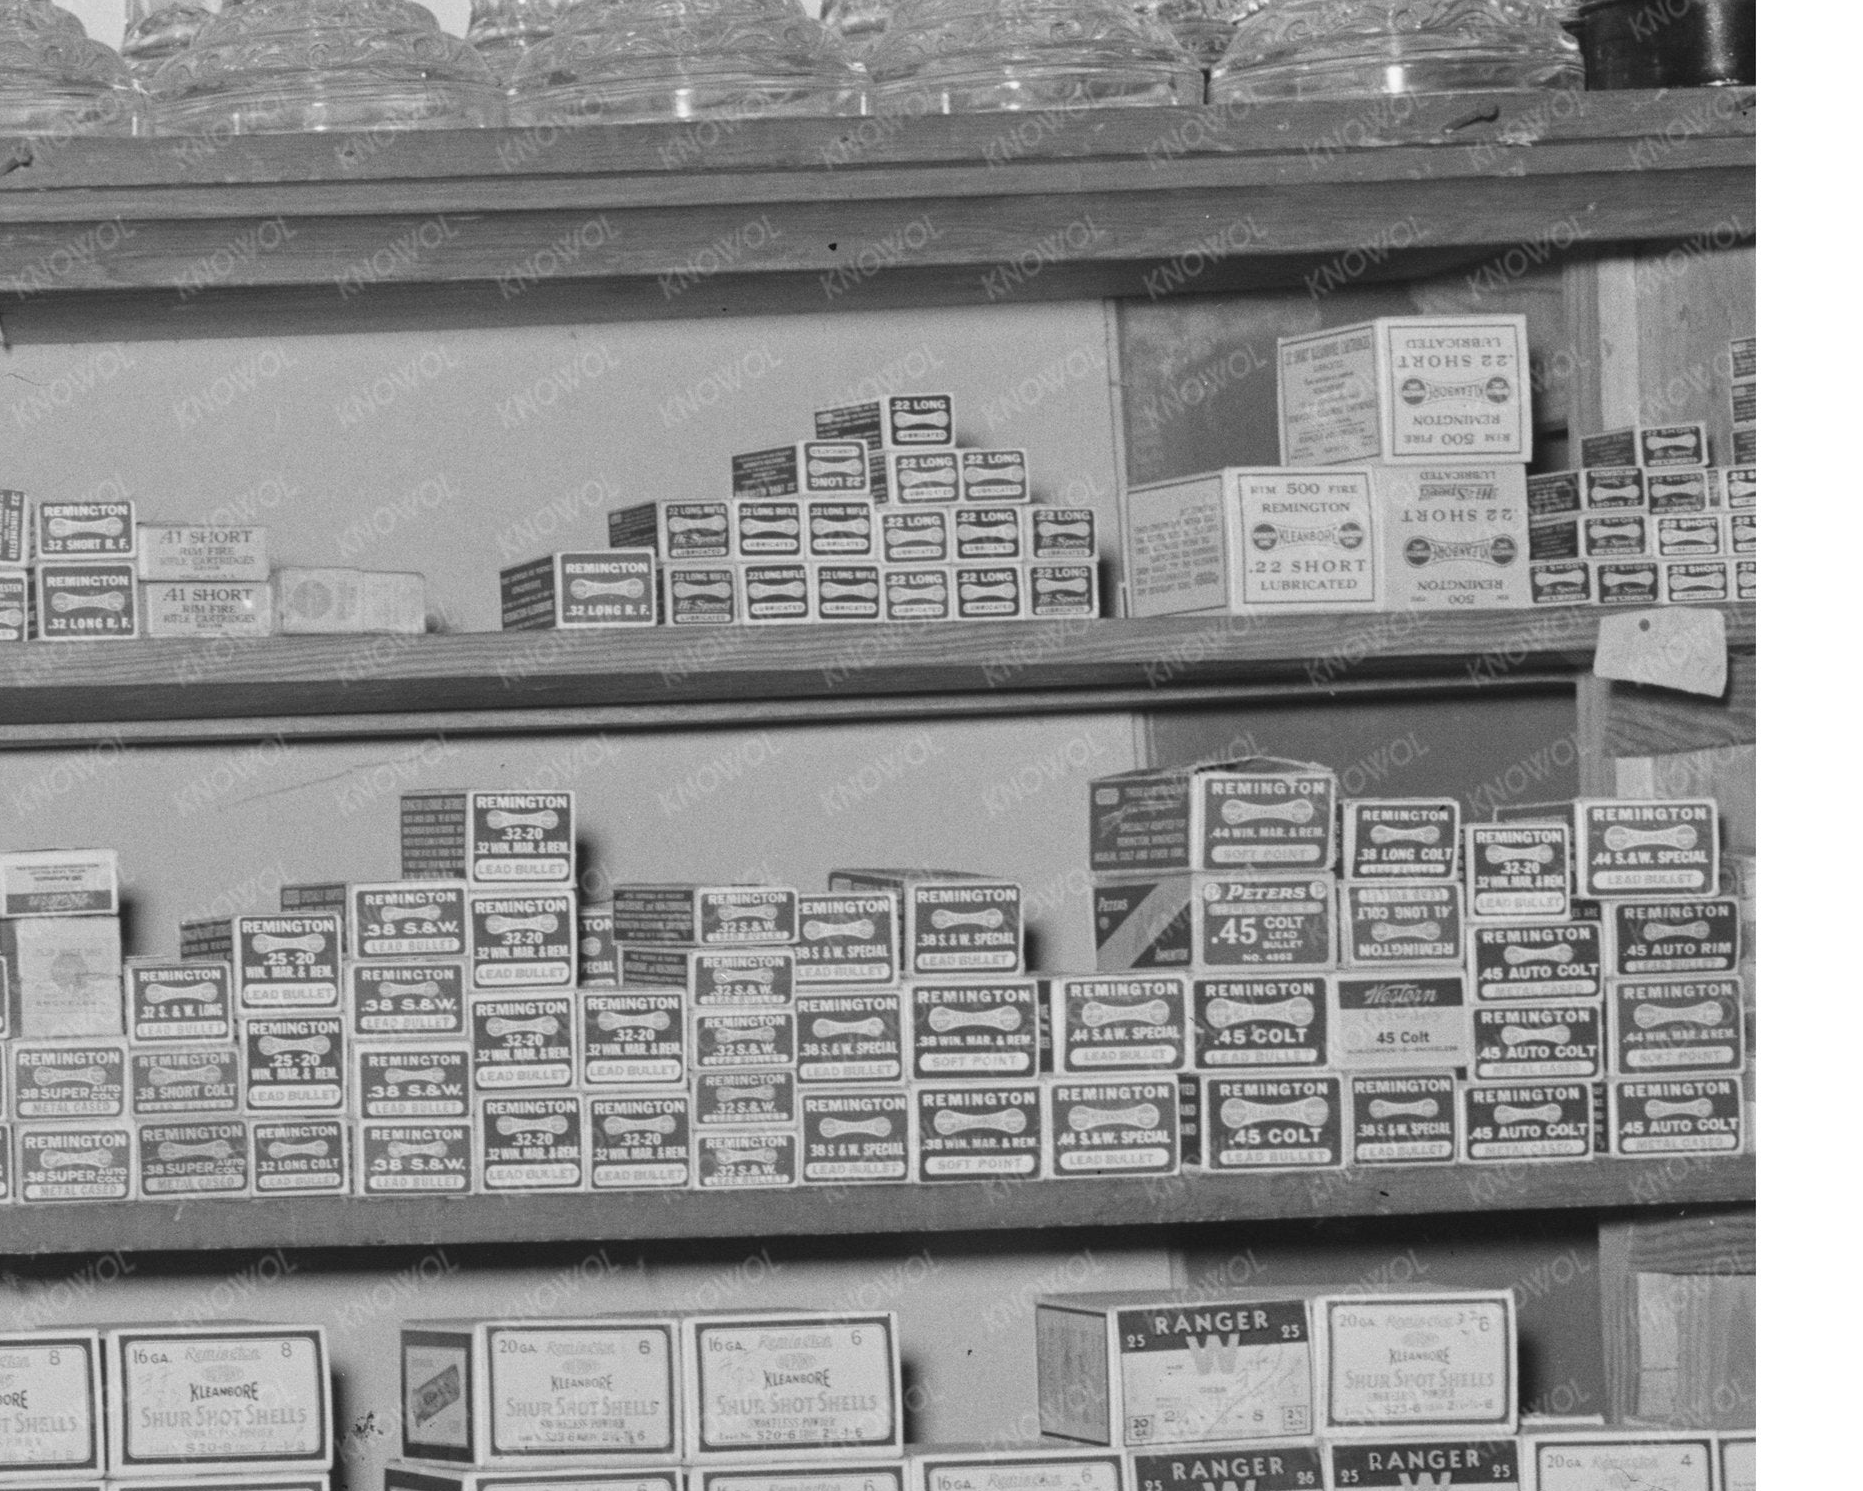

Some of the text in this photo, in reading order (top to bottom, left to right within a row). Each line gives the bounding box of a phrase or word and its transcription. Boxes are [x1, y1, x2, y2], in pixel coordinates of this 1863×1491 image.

[1413, 415, 1500, 426] REMINGTON
[1286, 482, 1357, 495] 500 FIRE
[42, 504, 129, 518] REMINGTON
[1262, 501, 1350, 513] REMINGTON
[191, 531, 252, 543] SHORT
[564, 557, 650, 580] REMINGTON
[1248, 560, 1366, 573] .22 SHORT
[1260, 578, 1357, 590] LUBRICATED
[193, 589, 253, 601] SHORT
[476, 795, 568, 809] REMINGTON
[915, 889, 1018, 903] REMINGTON
[241, 920, 335, 934] REMINGTON
[975, 933, 1015, 946] SPECIAL
[1481, 928, 1591, 944] REMINGTON
[1508, 963, 1599, 978] AUTO COLT
[1363, 985, 1438, 1004] Western
[1376, 1030, 1431, 1044] 45 Colt
[1153, 1310, 1269, 1336] RANGER
[1172, 1456, 1284, 1480] RANGER
